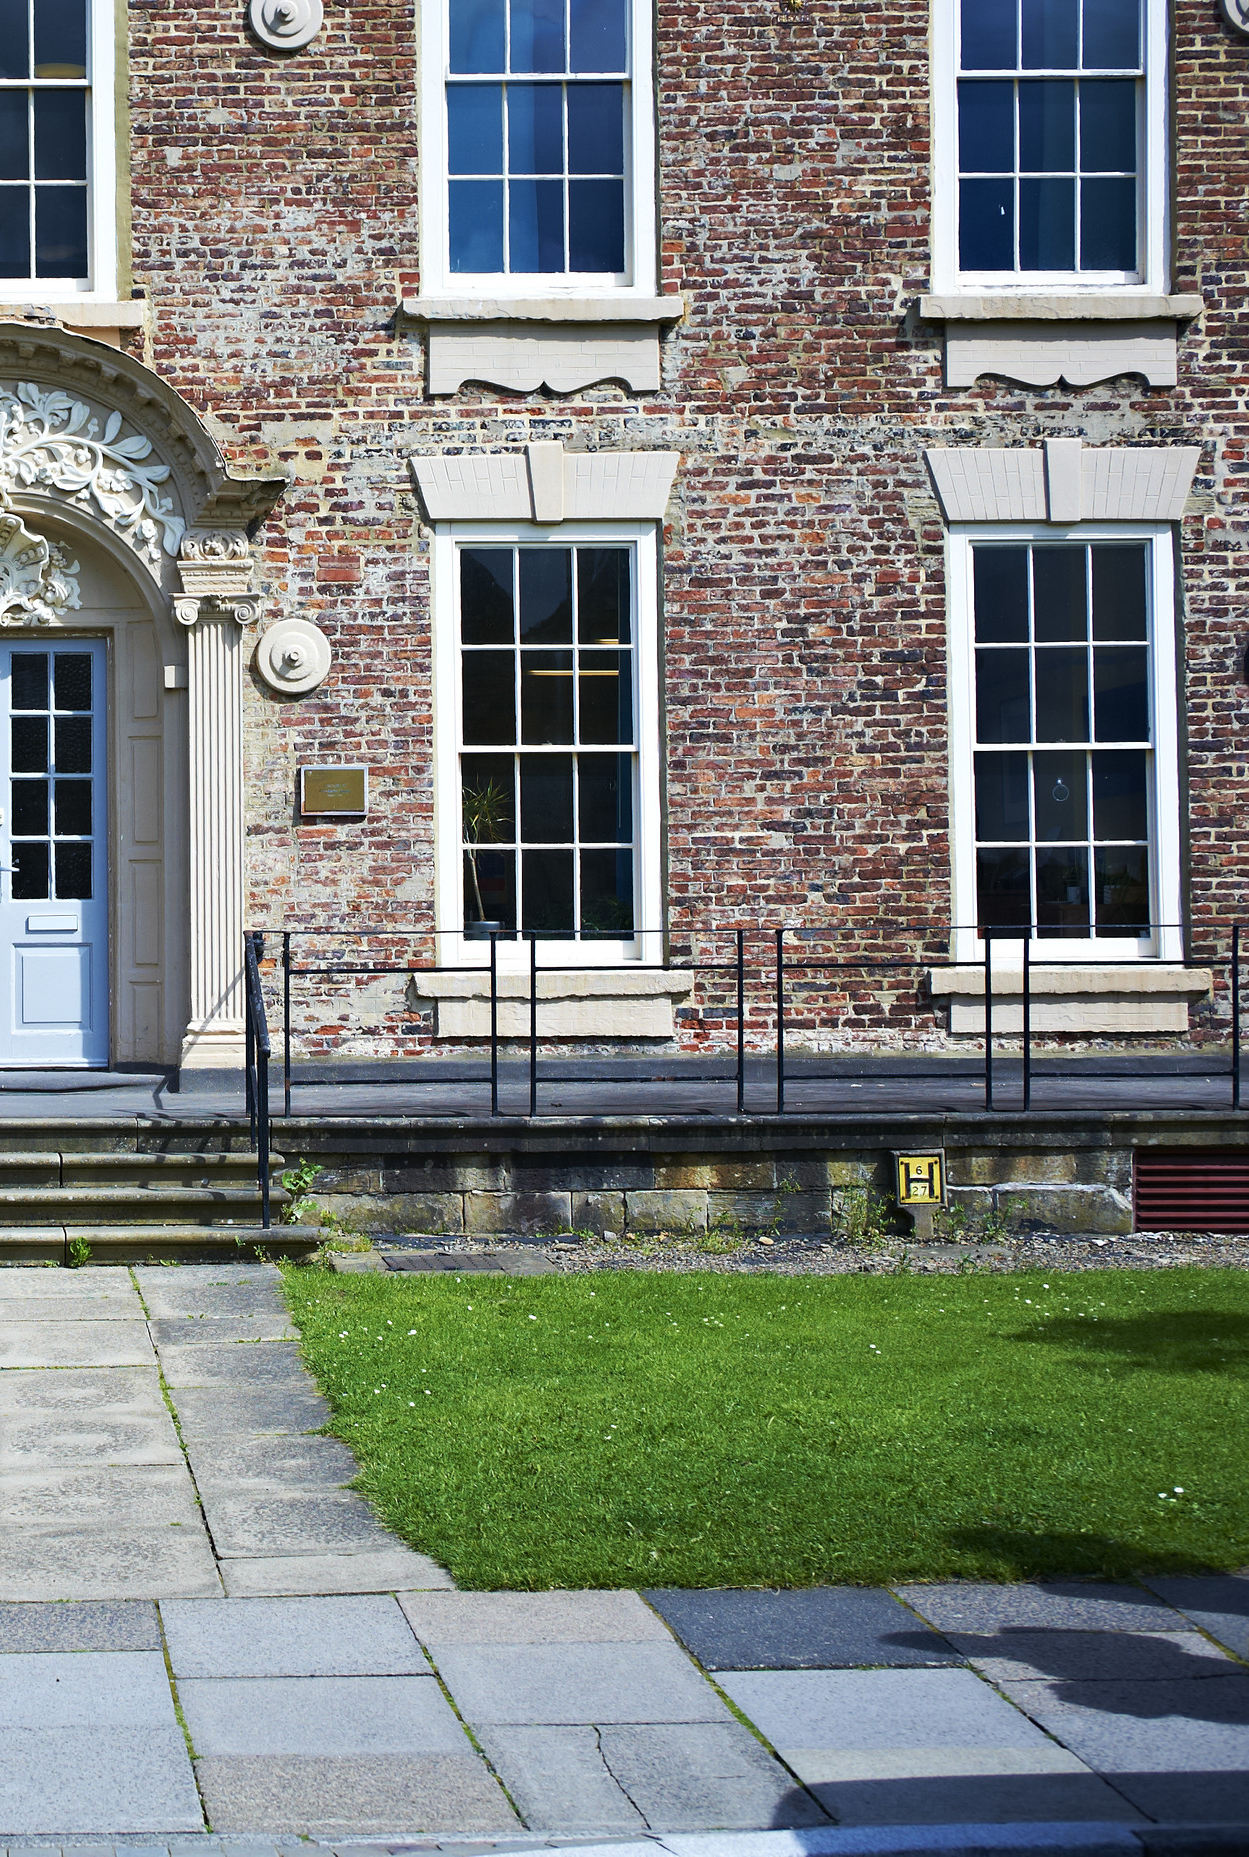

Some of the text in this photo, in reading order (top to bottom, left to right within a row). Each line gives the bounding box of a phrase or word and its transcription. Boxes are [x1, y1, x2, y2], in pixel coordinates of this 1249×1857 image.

[916, 1165, 923, 1175] 6
[904, 1163, 934, 1198] H
[912, 1186, 927, 1196] 27
